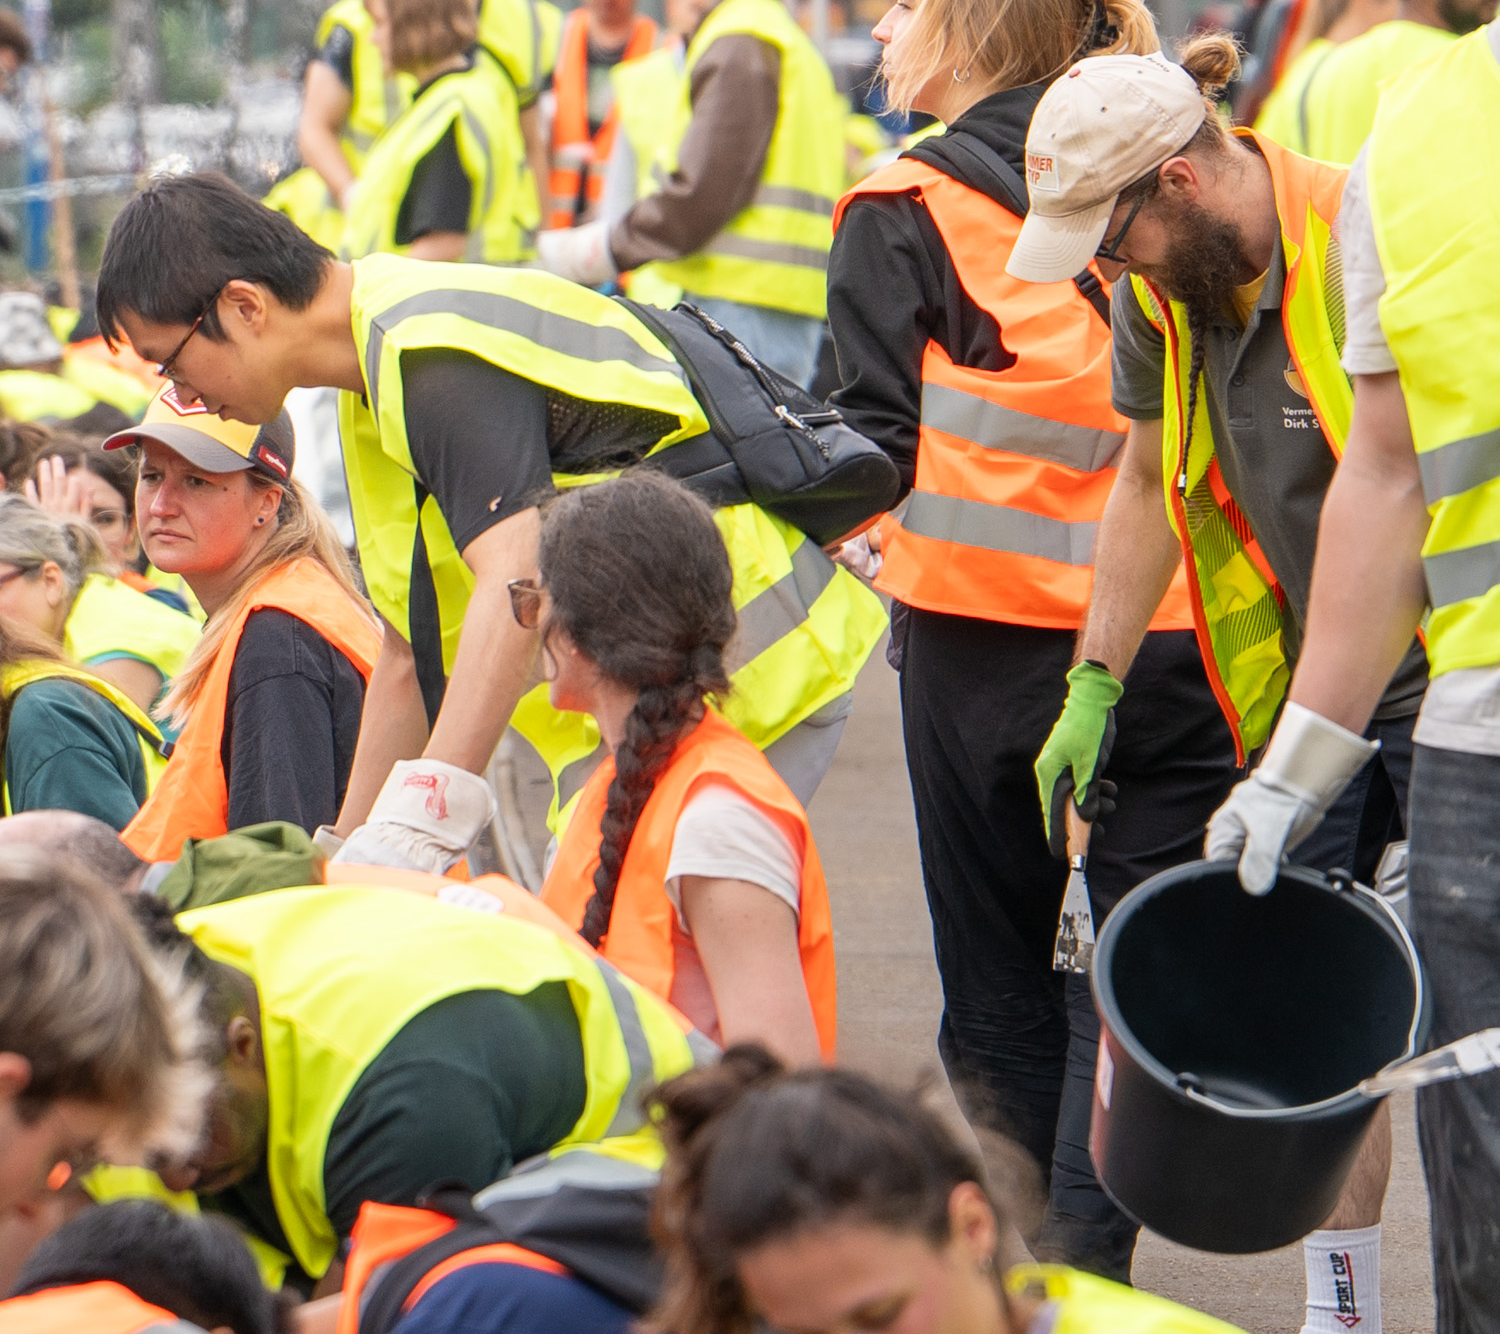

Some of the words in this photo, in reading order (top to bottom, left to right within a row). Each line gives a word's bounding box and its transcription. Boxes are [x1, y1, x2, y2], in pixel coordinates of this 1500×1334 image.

[1282, 407, 1317, 416] Verme
[1283, 418, 1309, 429] Dirk
[1330, 1252, 1347, 1275] CUP
[1335, 1278, 1352, 1314] SPORT
